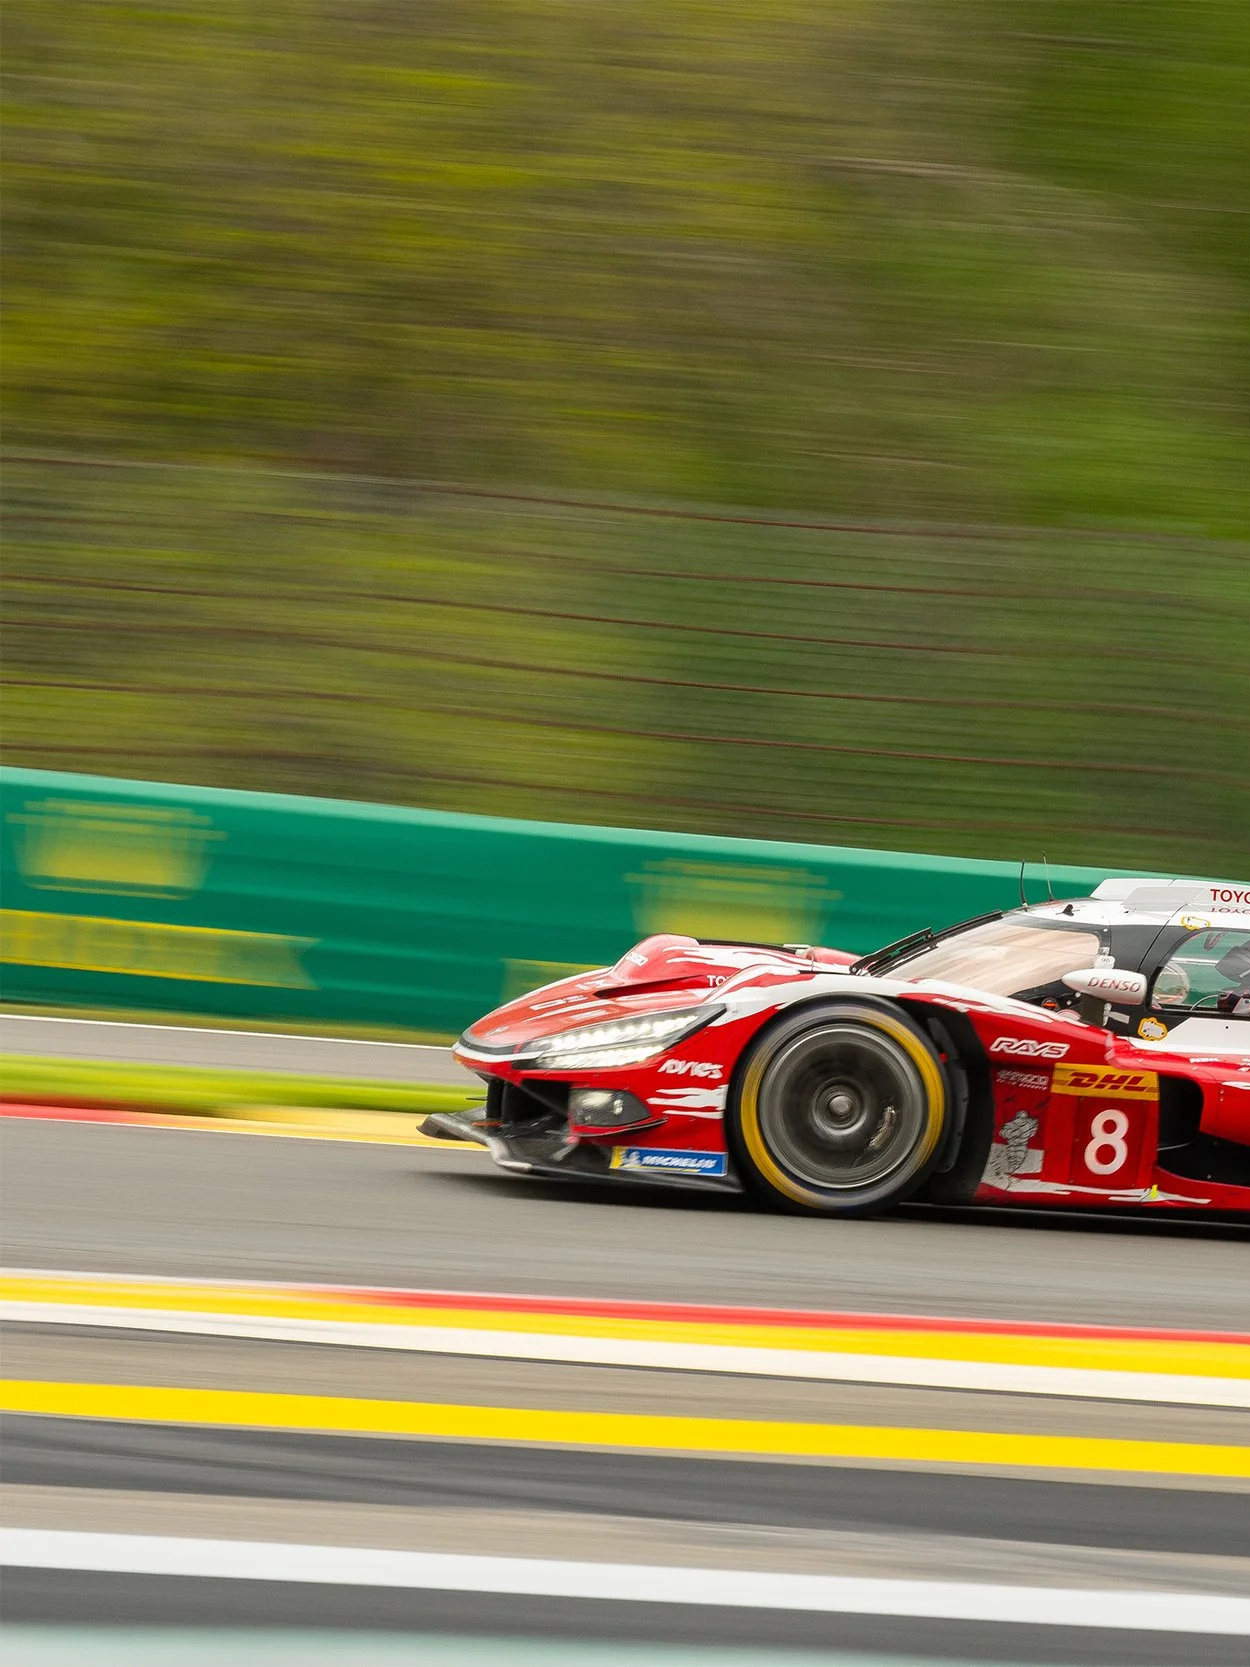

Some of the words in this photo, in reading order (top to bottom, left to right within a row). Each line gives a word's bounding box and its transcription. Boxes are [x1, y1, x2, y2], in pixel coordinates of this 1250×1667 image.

[1088, 977, 1141, 993] DENSO
[990, 1037, 1070, 1058] RAYS
[1065, 1072, 1149, 1092] DHL
[1084, 1109, 1130, 1175] 8
[641, 1155, 718, 1169] MICHELIN
